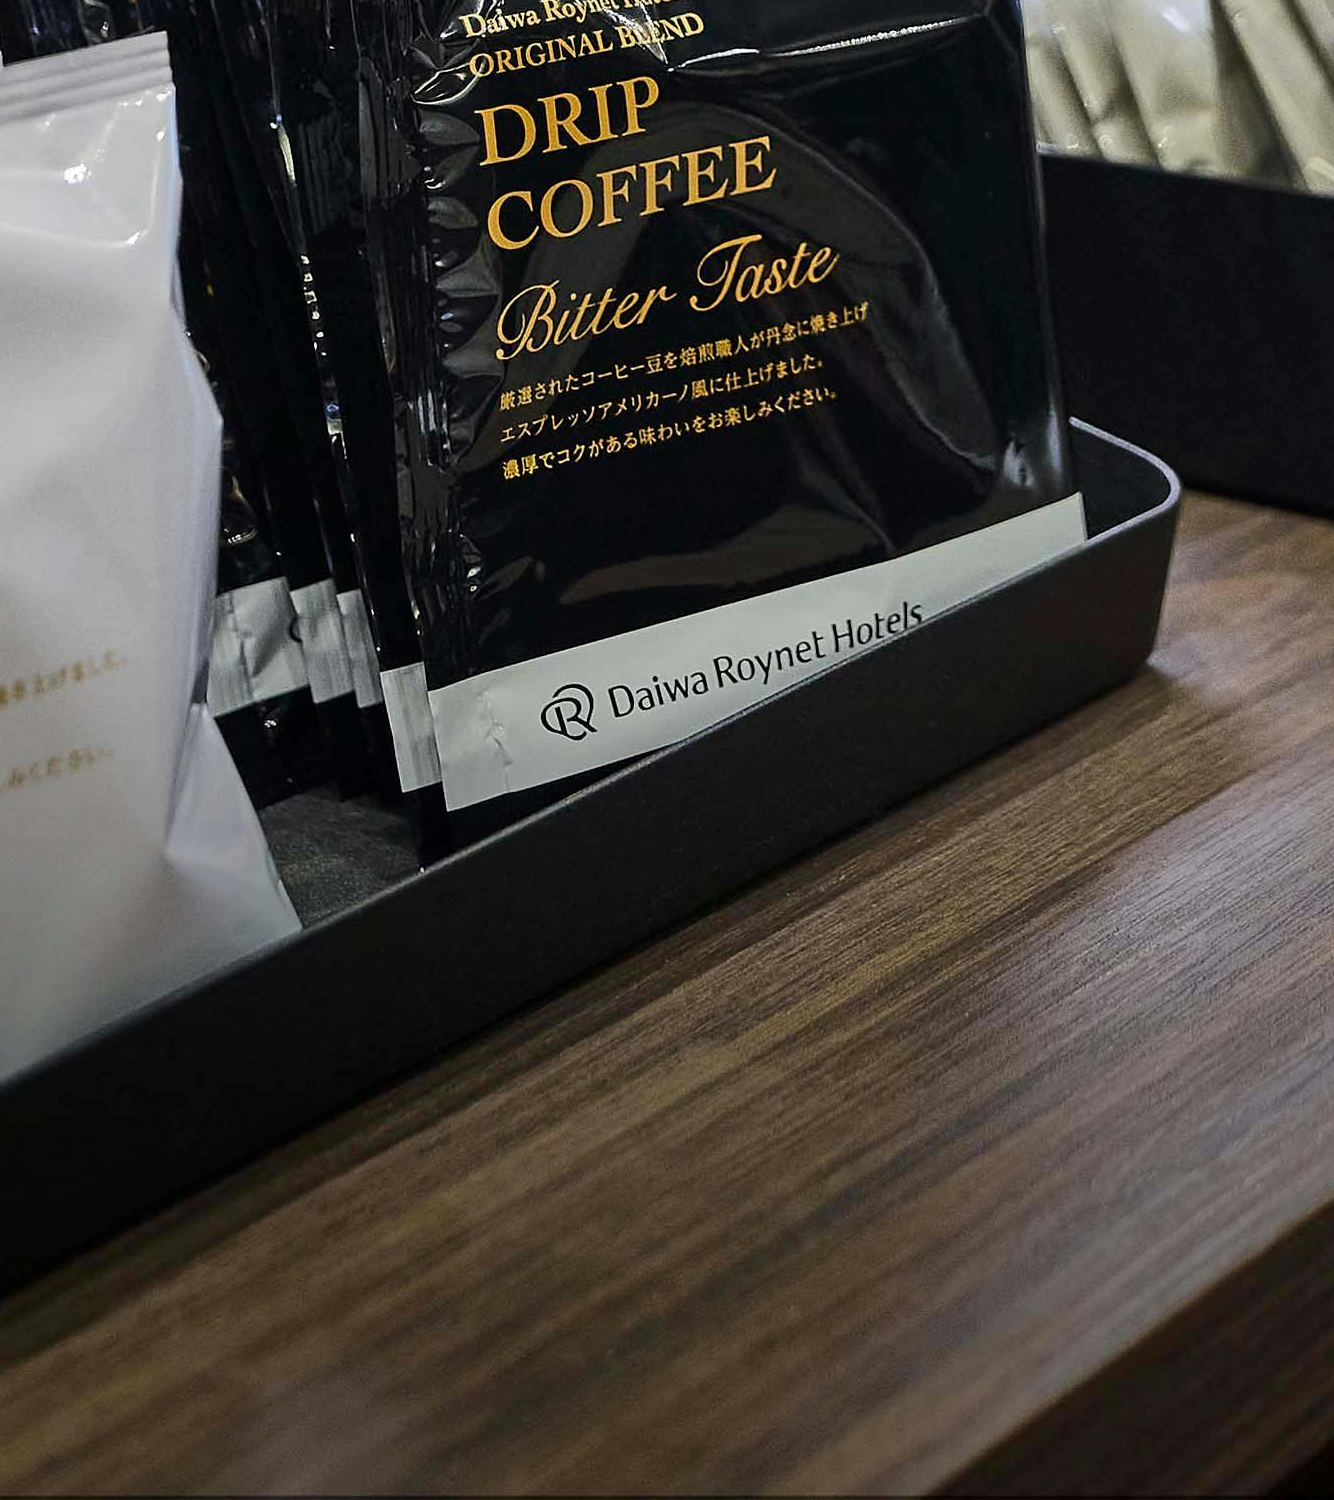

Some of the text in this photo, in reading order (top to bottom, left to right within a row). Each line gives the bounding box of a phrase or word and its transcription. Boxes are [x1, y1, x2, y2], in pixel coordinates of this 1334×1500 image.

[459, 8, 541, 38] Daiwa
[469, 12, 704, 77] ORIGINAL BLEND
[474, 75, 660, 166] DRIP
[487, 136, 776, 251] COFFEE
[496, 234, 840, 360] Bitter Taste
[499, 301, 869, 411] 厳選されたコーヒー豆を焙煎職人が丹念に焼き上げ
[500, 353, 825, 443] エスプレッソアメリカーノ風に仕上げました。
[503, 387, 838, 479] 濃厚でコクがある味わいをお楽しみください。
[608, 668, 710, 719] Daiwa
[713, 631, 826, 686] Roynet
[831, 601, 923, 655] Hotels
